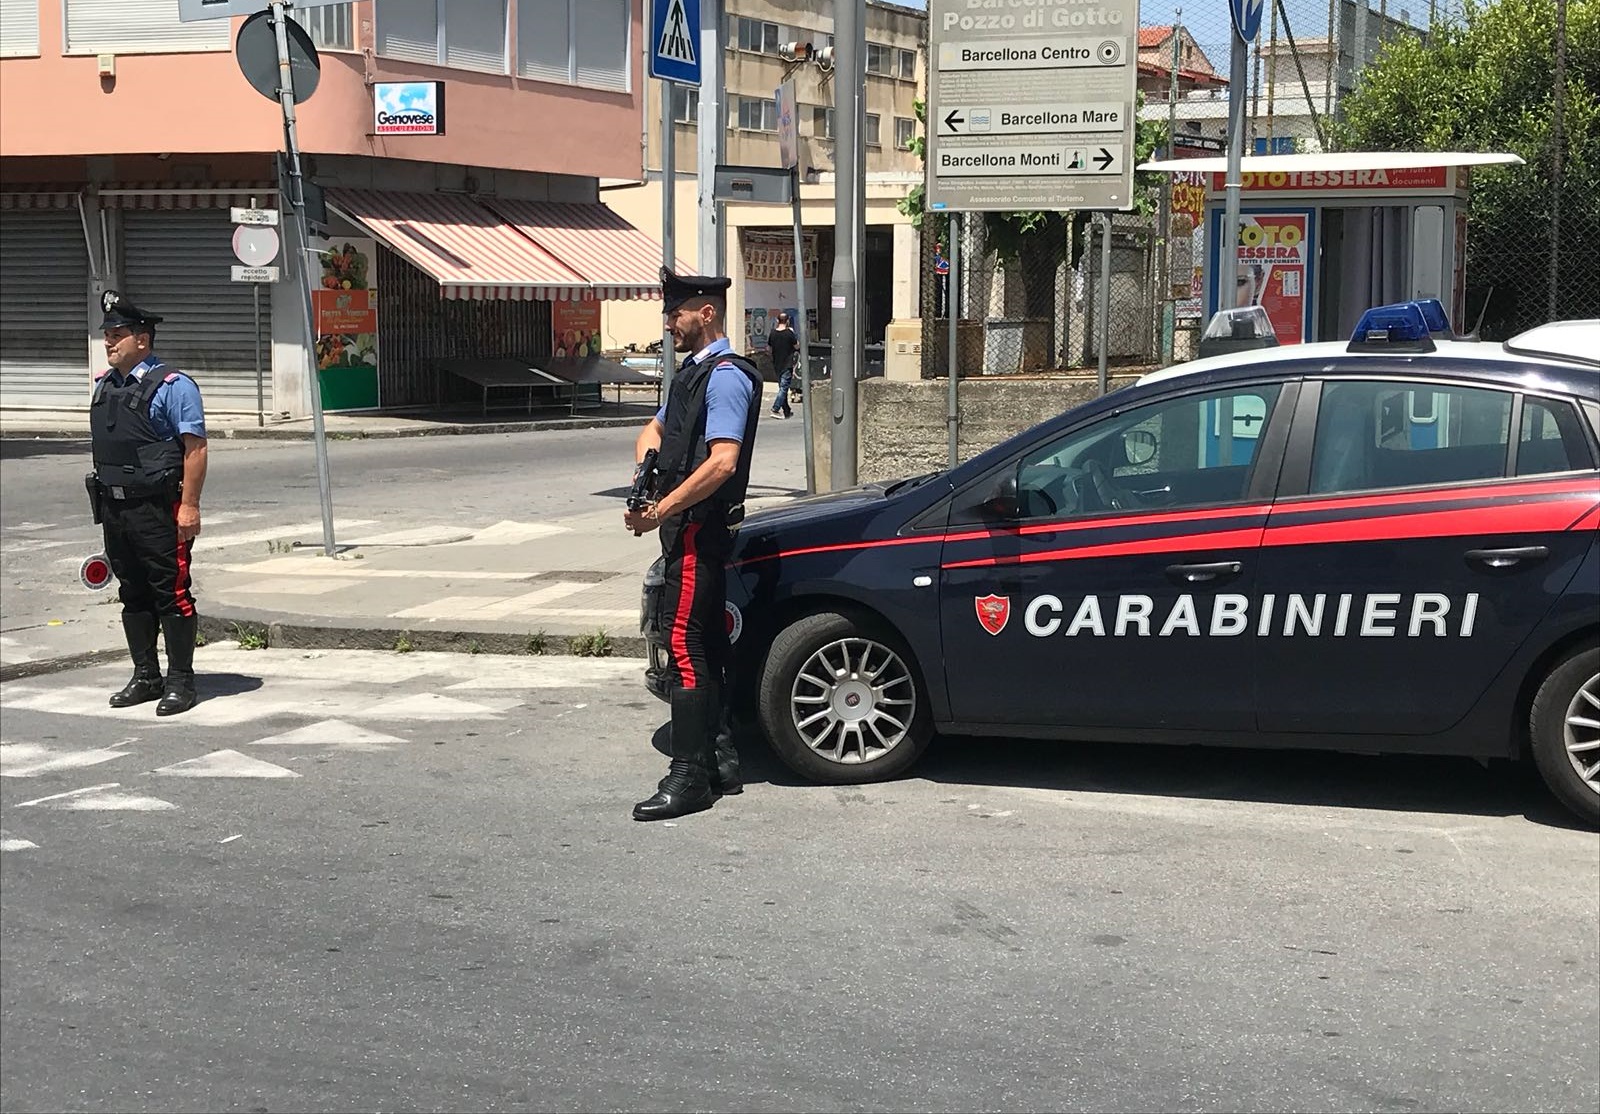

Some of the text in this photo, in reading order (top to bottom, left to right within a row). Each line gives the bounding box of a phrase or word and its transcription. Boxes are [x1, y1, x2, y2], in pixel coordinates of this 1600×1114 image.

[943, 7, 1123, 31] Pozzo di Gotto
[961, 46, 1091, 62] Barcellona Centro
[377, 111, 434, 125] Genovese
[1001, 110, 1119, 126] Barcellona Mare
[941, 152, 1060, 167] Barcellona Monti
[1239, 169, 1390, 187] OTOTESSERA
[969, 195, 1012, 203] Assessorato
[1239, 225, 1302, 247] OTO
[1238, 247, 1301, 258] ESSERA
[1023, 593, 1480, 637] CARABINIERI
